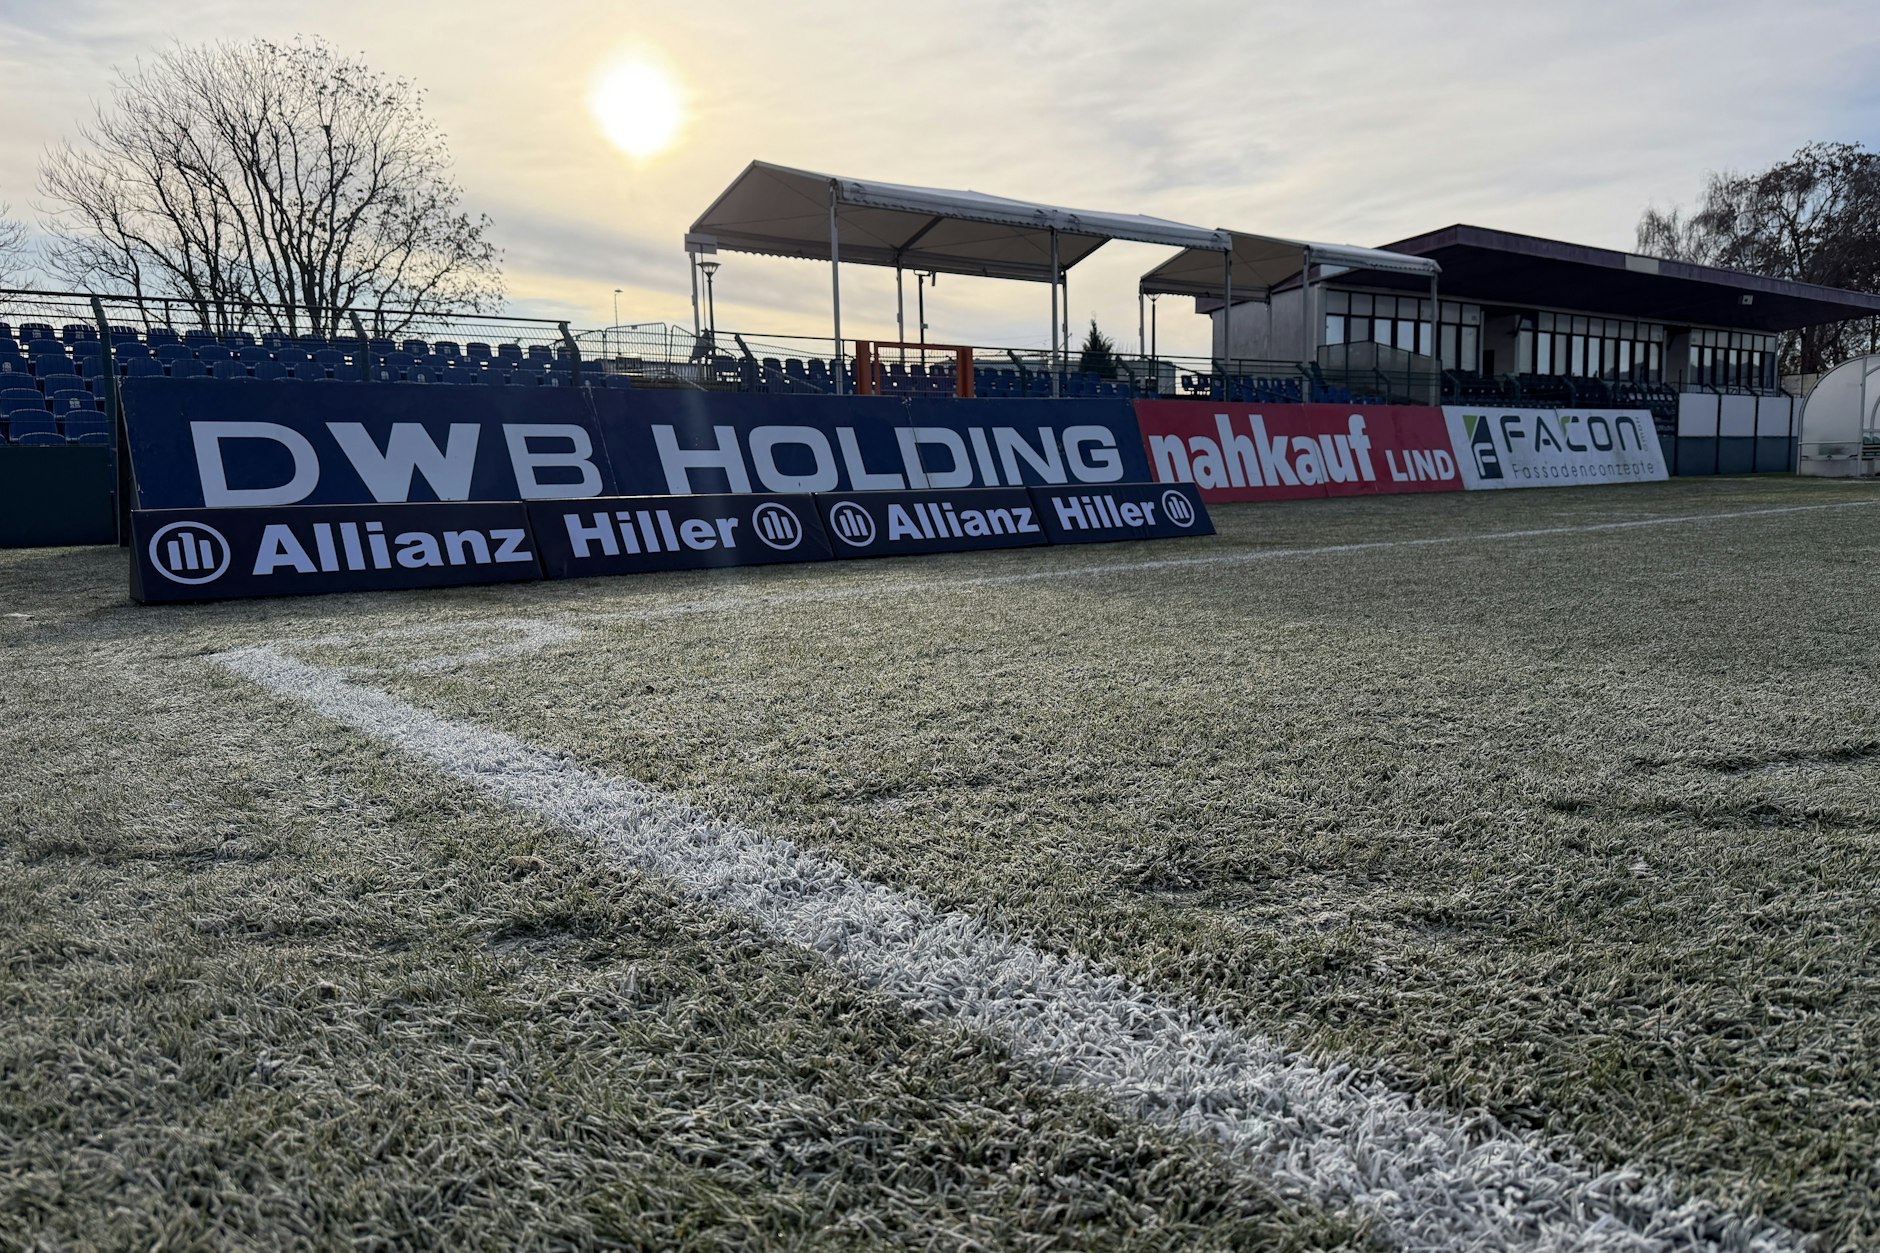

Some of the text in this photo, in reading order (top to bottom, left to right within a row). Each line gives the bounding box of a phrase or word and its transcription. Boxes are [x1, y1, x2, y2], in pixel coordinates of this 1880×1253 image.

[190, 421, 1124, 507] DWB HOLDING
[1148, 413, 1456, 490] nahkauf LIND
[1512, 461, 1655, 480] Fassadenconzepte
[252, 509, 738, 576] Allianz Hiller
[888, 494, 1156, 541] Allianz Hiller
